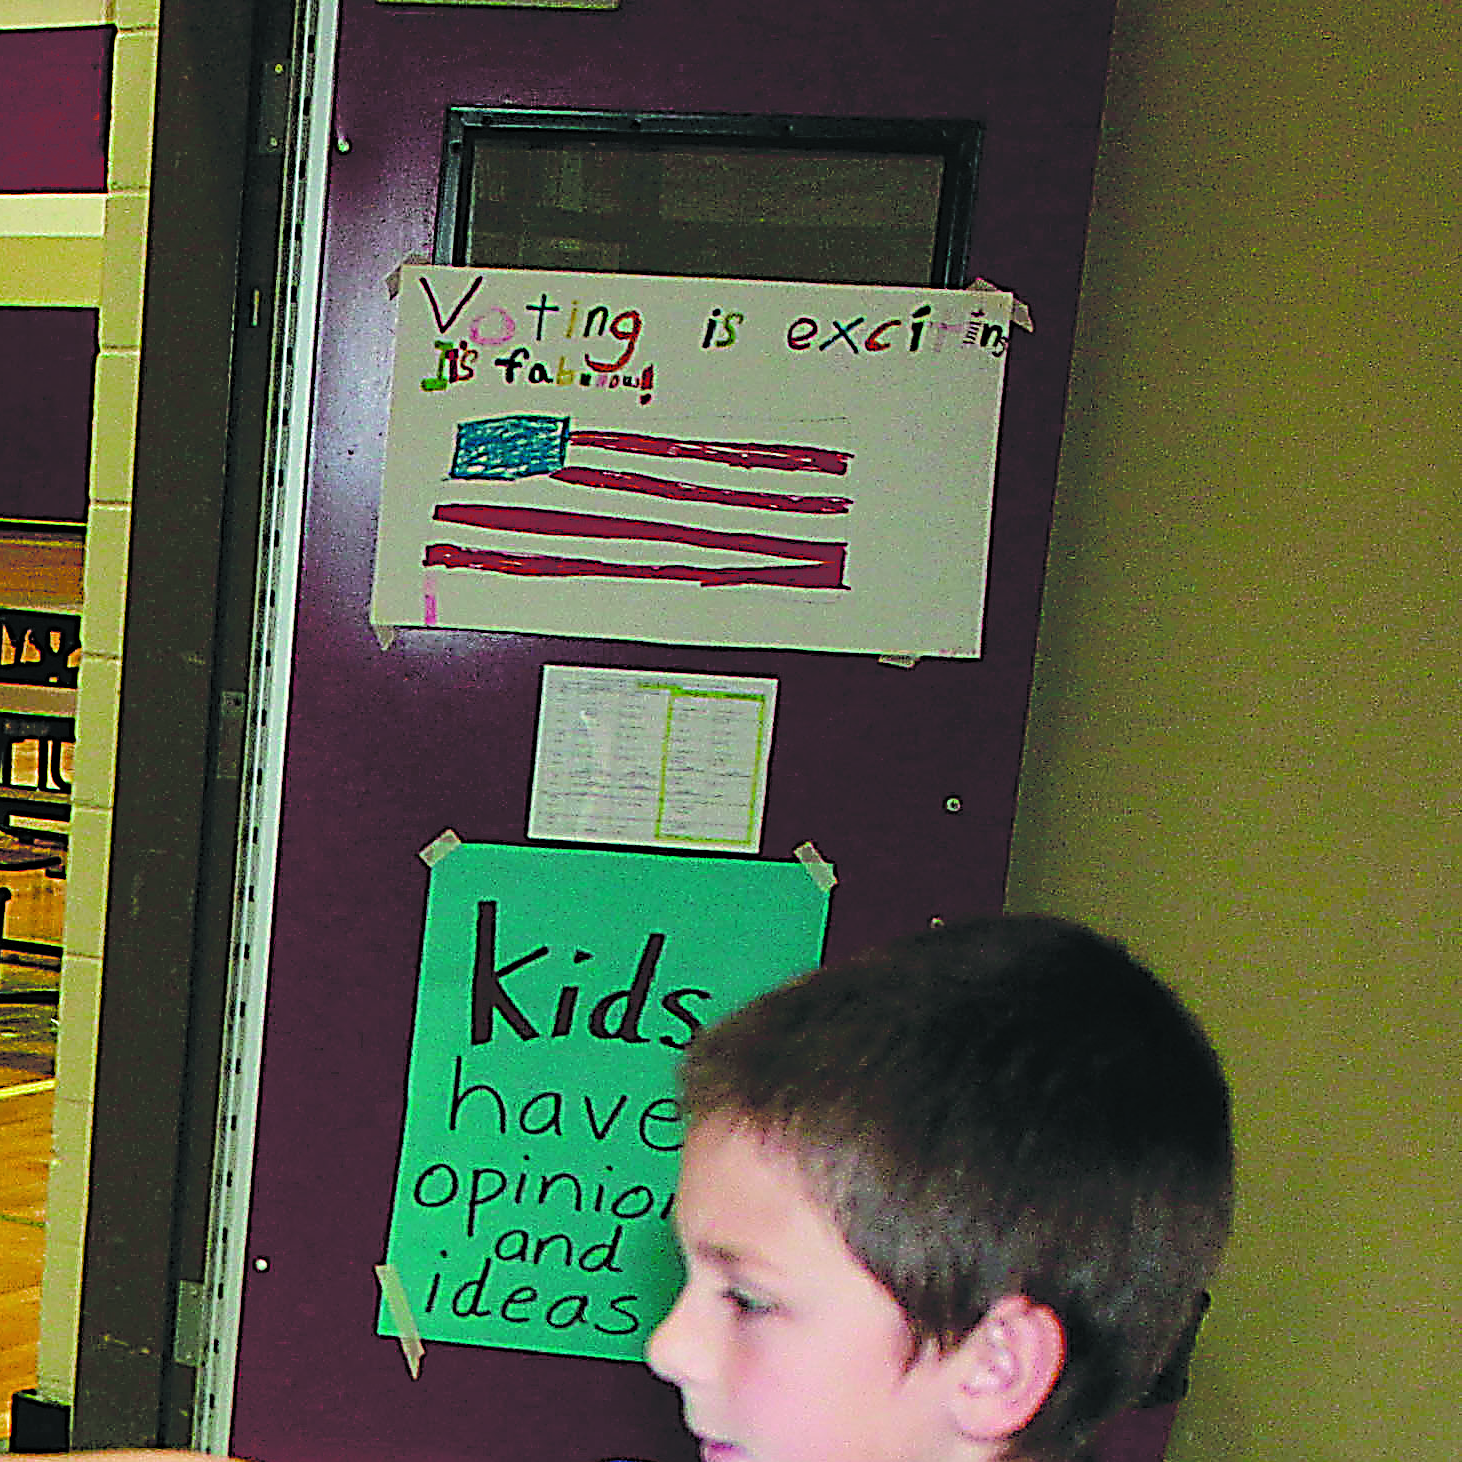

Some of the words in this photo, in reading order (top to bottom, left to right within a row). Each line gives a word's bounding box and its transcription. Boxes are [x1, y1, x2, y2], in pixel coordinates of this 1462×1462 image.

[419, 276, 643, 373] Voting
[699, 310, 744, 348] is
[449, 1055, 685, 1152] have
[413, 1154, 676, 1237] opinio
[494, 1225, 623, 1273] and
[425, 1250, 641, 1335] ideas
